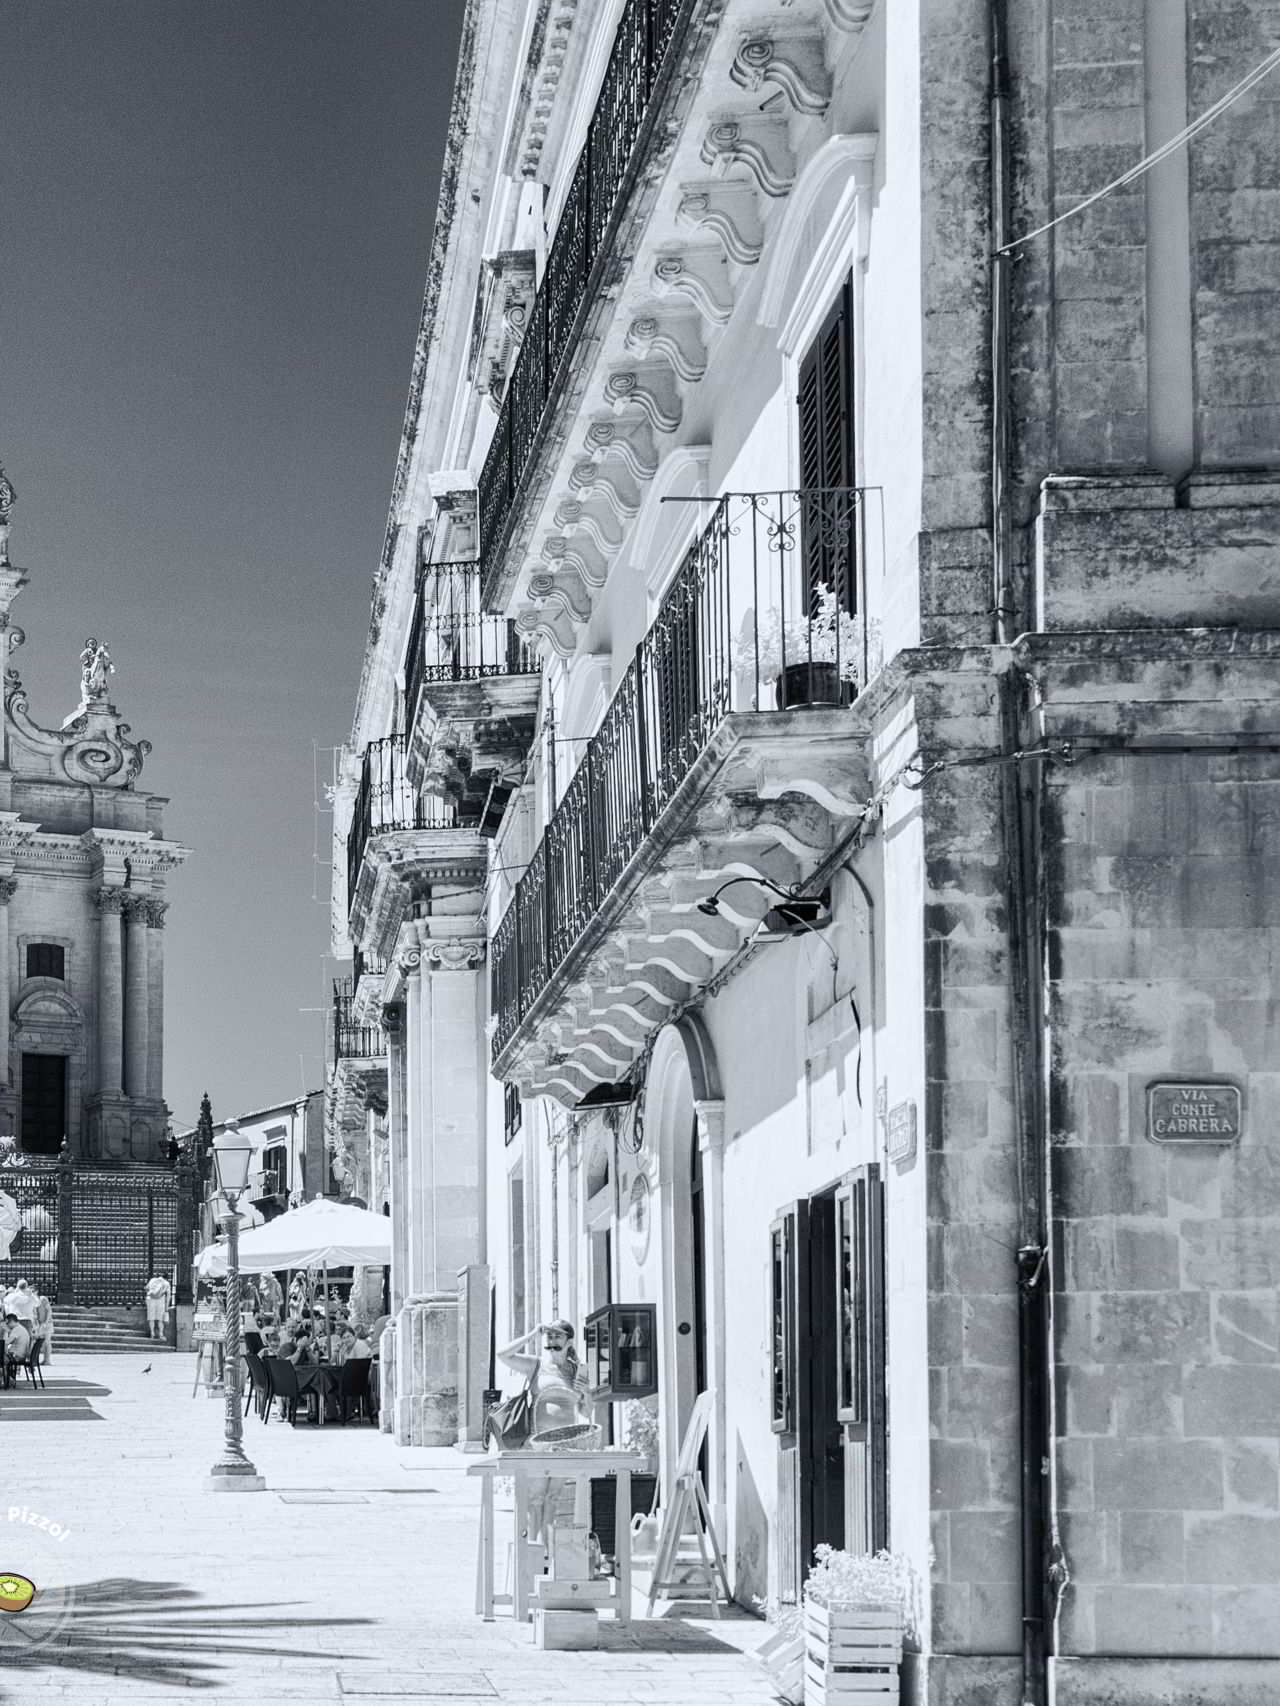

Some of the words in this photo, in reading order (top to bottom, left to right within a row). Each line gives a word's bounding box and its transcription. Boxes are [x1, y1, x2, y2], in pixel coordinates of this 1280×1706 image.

[1181, 1089, 1208, 1101] VIA
[1172, 1103, 1217, 1117] CONTE
[1155, 1118, 1233, 1133] CABRERA
